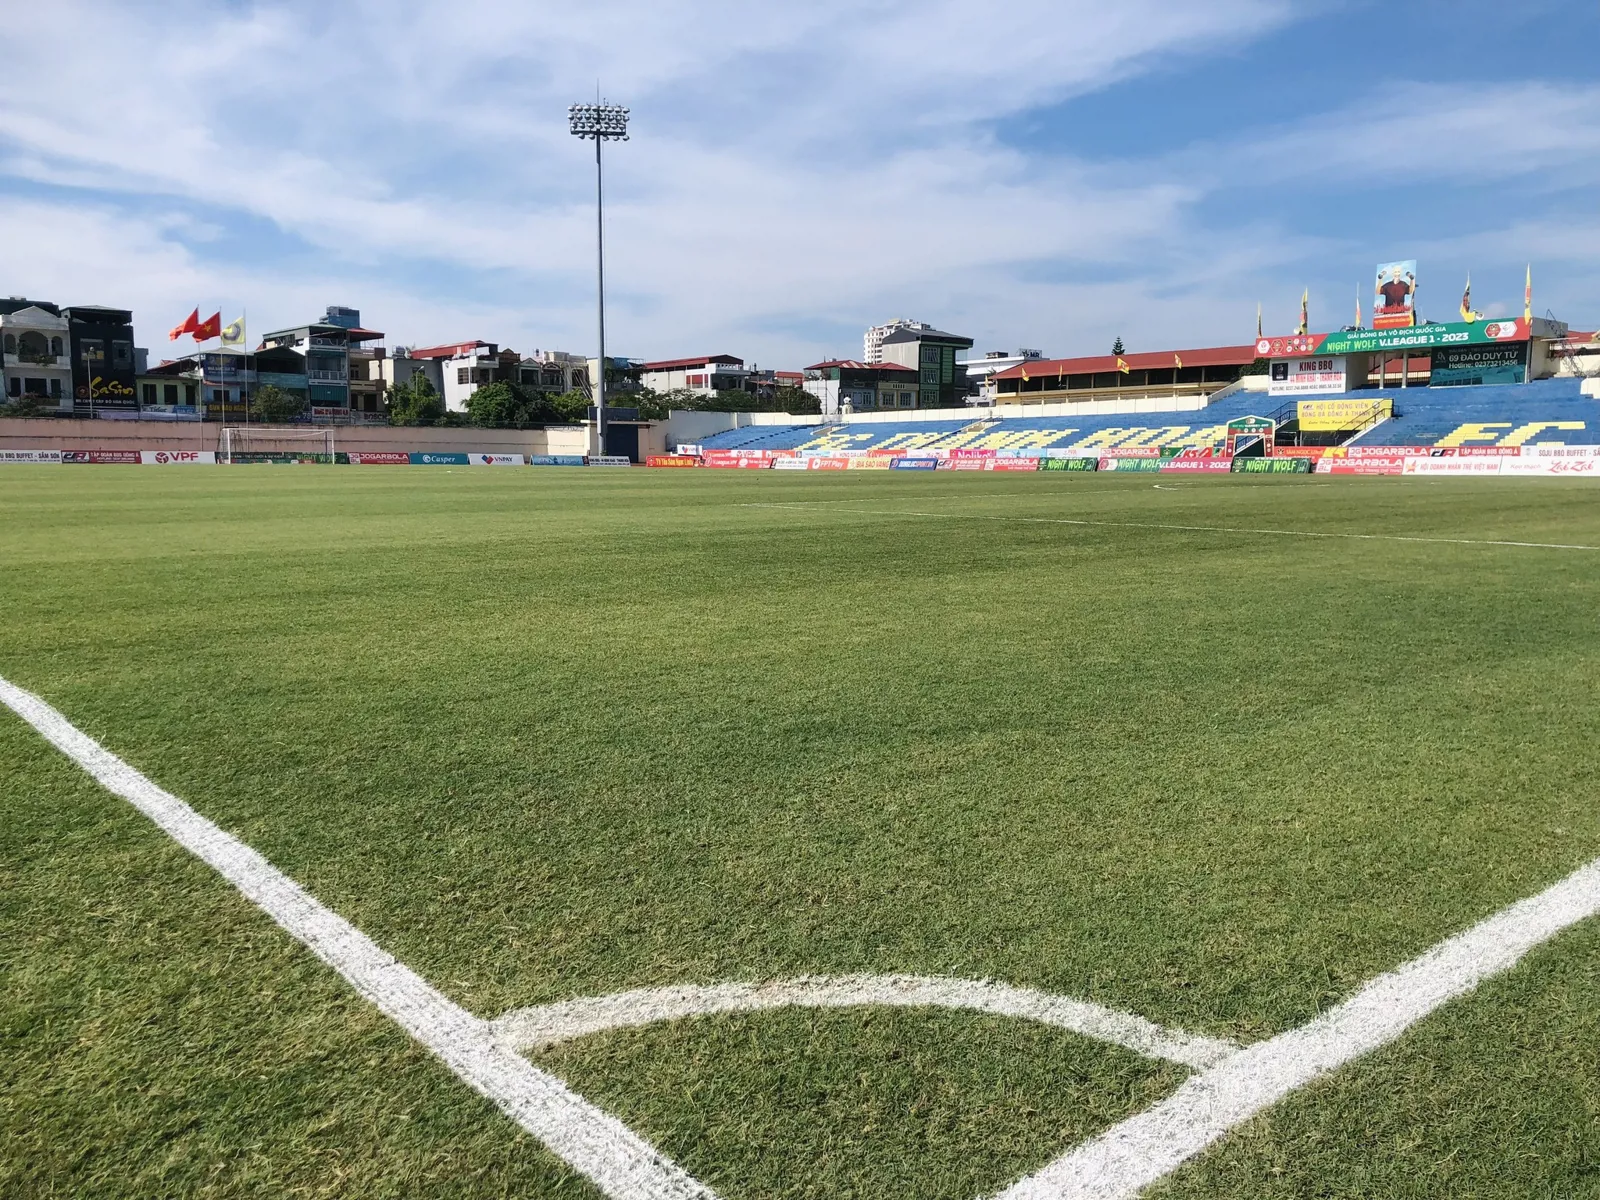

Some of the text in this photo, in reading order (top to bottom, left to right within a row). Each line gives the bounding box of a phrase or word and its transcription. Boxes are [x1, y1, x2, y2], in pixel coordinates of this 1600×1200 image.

[1327, 341, 1351, 352] NIGHT
[1353, 339, 1377, 351] WOLF
[1379, 335, 1428, 347] V.LEAGUE
[1441, 332, 1469, 342] 2023
[1449, 354, 1459, 362] 69
[1483, 352, 1502, 360] DUY
[1299, 360, 1333, 371] KING BBQ
[170, 451, 199, 461] VPF
[1361, 447, 1428, 456] JOGARBOLA
[1539, 449, 1552, 457] SOJU
[1554, 449, 1565, 457] BBQ
[1567, 448, 1587, 457] BUFFET
[431, 455, 456, 464] Casper
[821, 460, 844, 469] FPT Play
[856, 460, 864, 468] BIA
[865, 460, 875, 468] SAO
[1047, 459, 1067, 470] NIGHT
[1068, 459, 1086, 470] WOLF
[1118, 459, 1139, 469] NIGHT
[1140, 459, 1161, 469] WOLF
[1160, 461, 1199, 469] V.LEAGUE
[1209, 461, 1231, 469] 2023
[1331, 458, 1402, 467] JOGARBOLA
[1246, 460, 1297, 472] NIGHT WOLF
